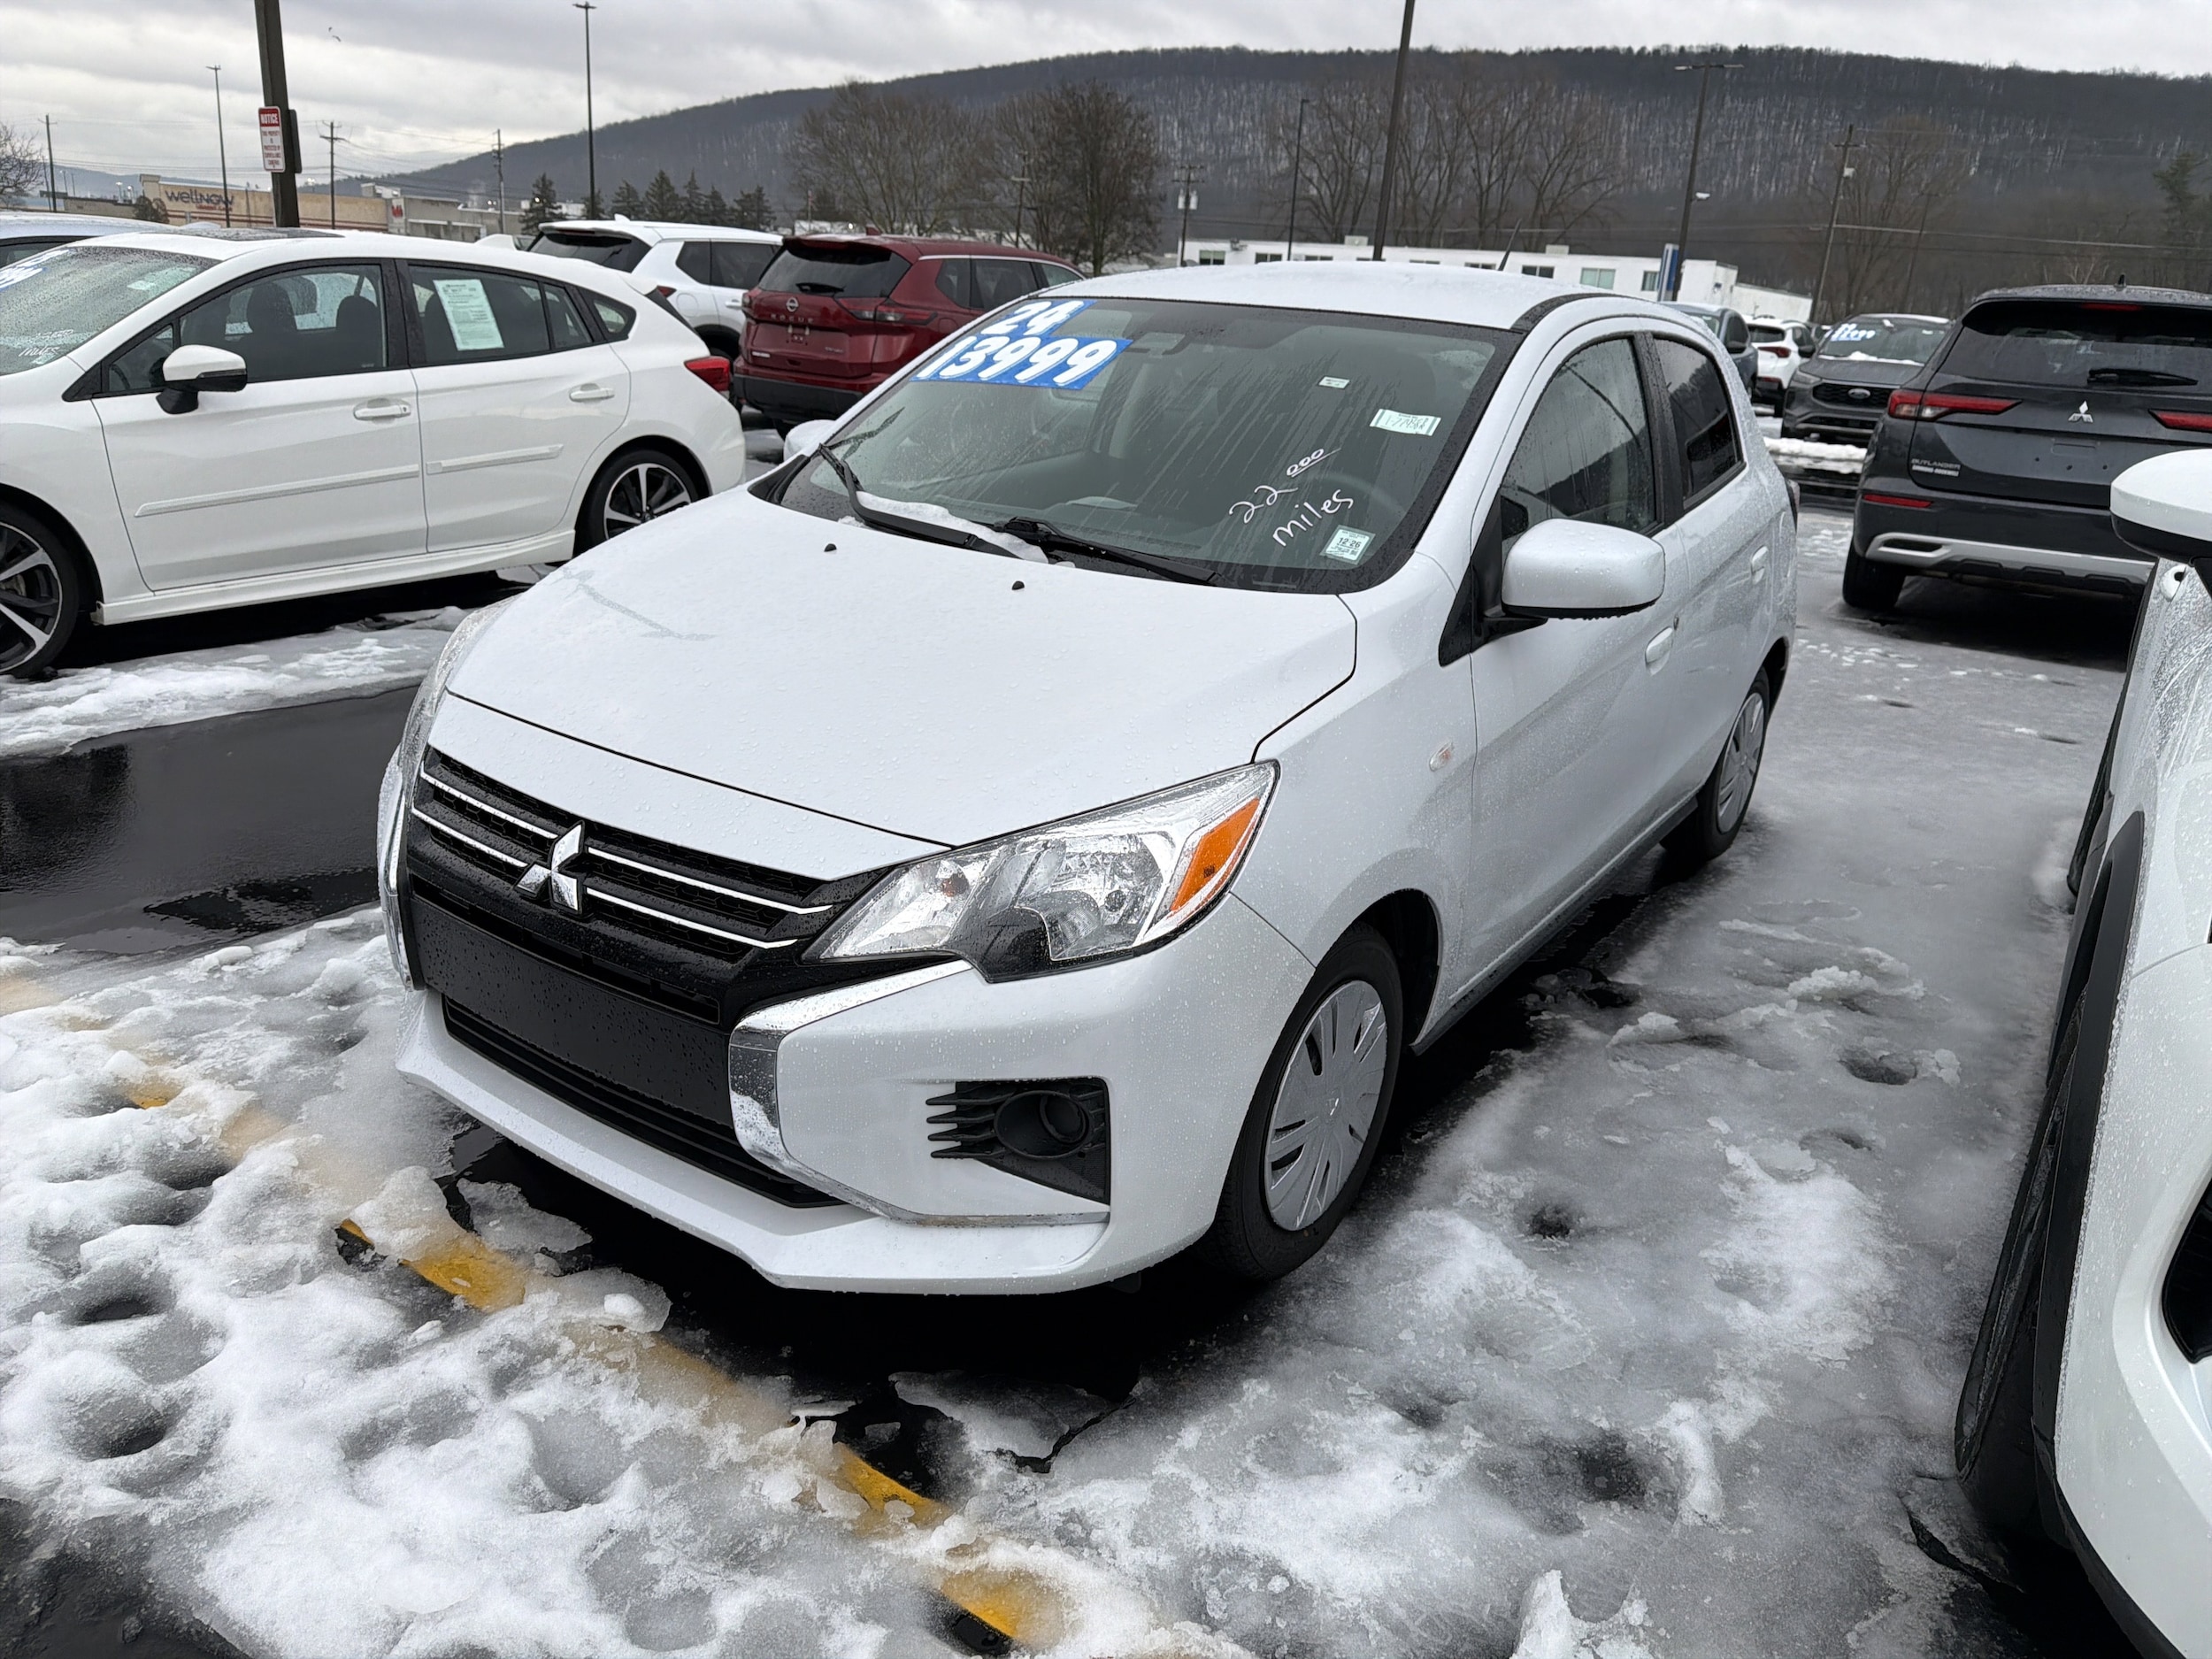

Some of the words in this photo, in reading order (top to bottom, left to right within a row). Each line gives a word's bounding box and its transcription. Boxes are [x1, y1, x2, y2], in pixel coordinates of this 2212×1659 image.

[260, 113, 279, 124] NOTICE
[771, 313, 814, 325] ROGUE
[980, 300, 1085, 336] 24
[917, 335, 1118, 387] 13999
[1911, 458, 1961, 470] OUTLANDER
[1272, 489, 1354, 547] miles
